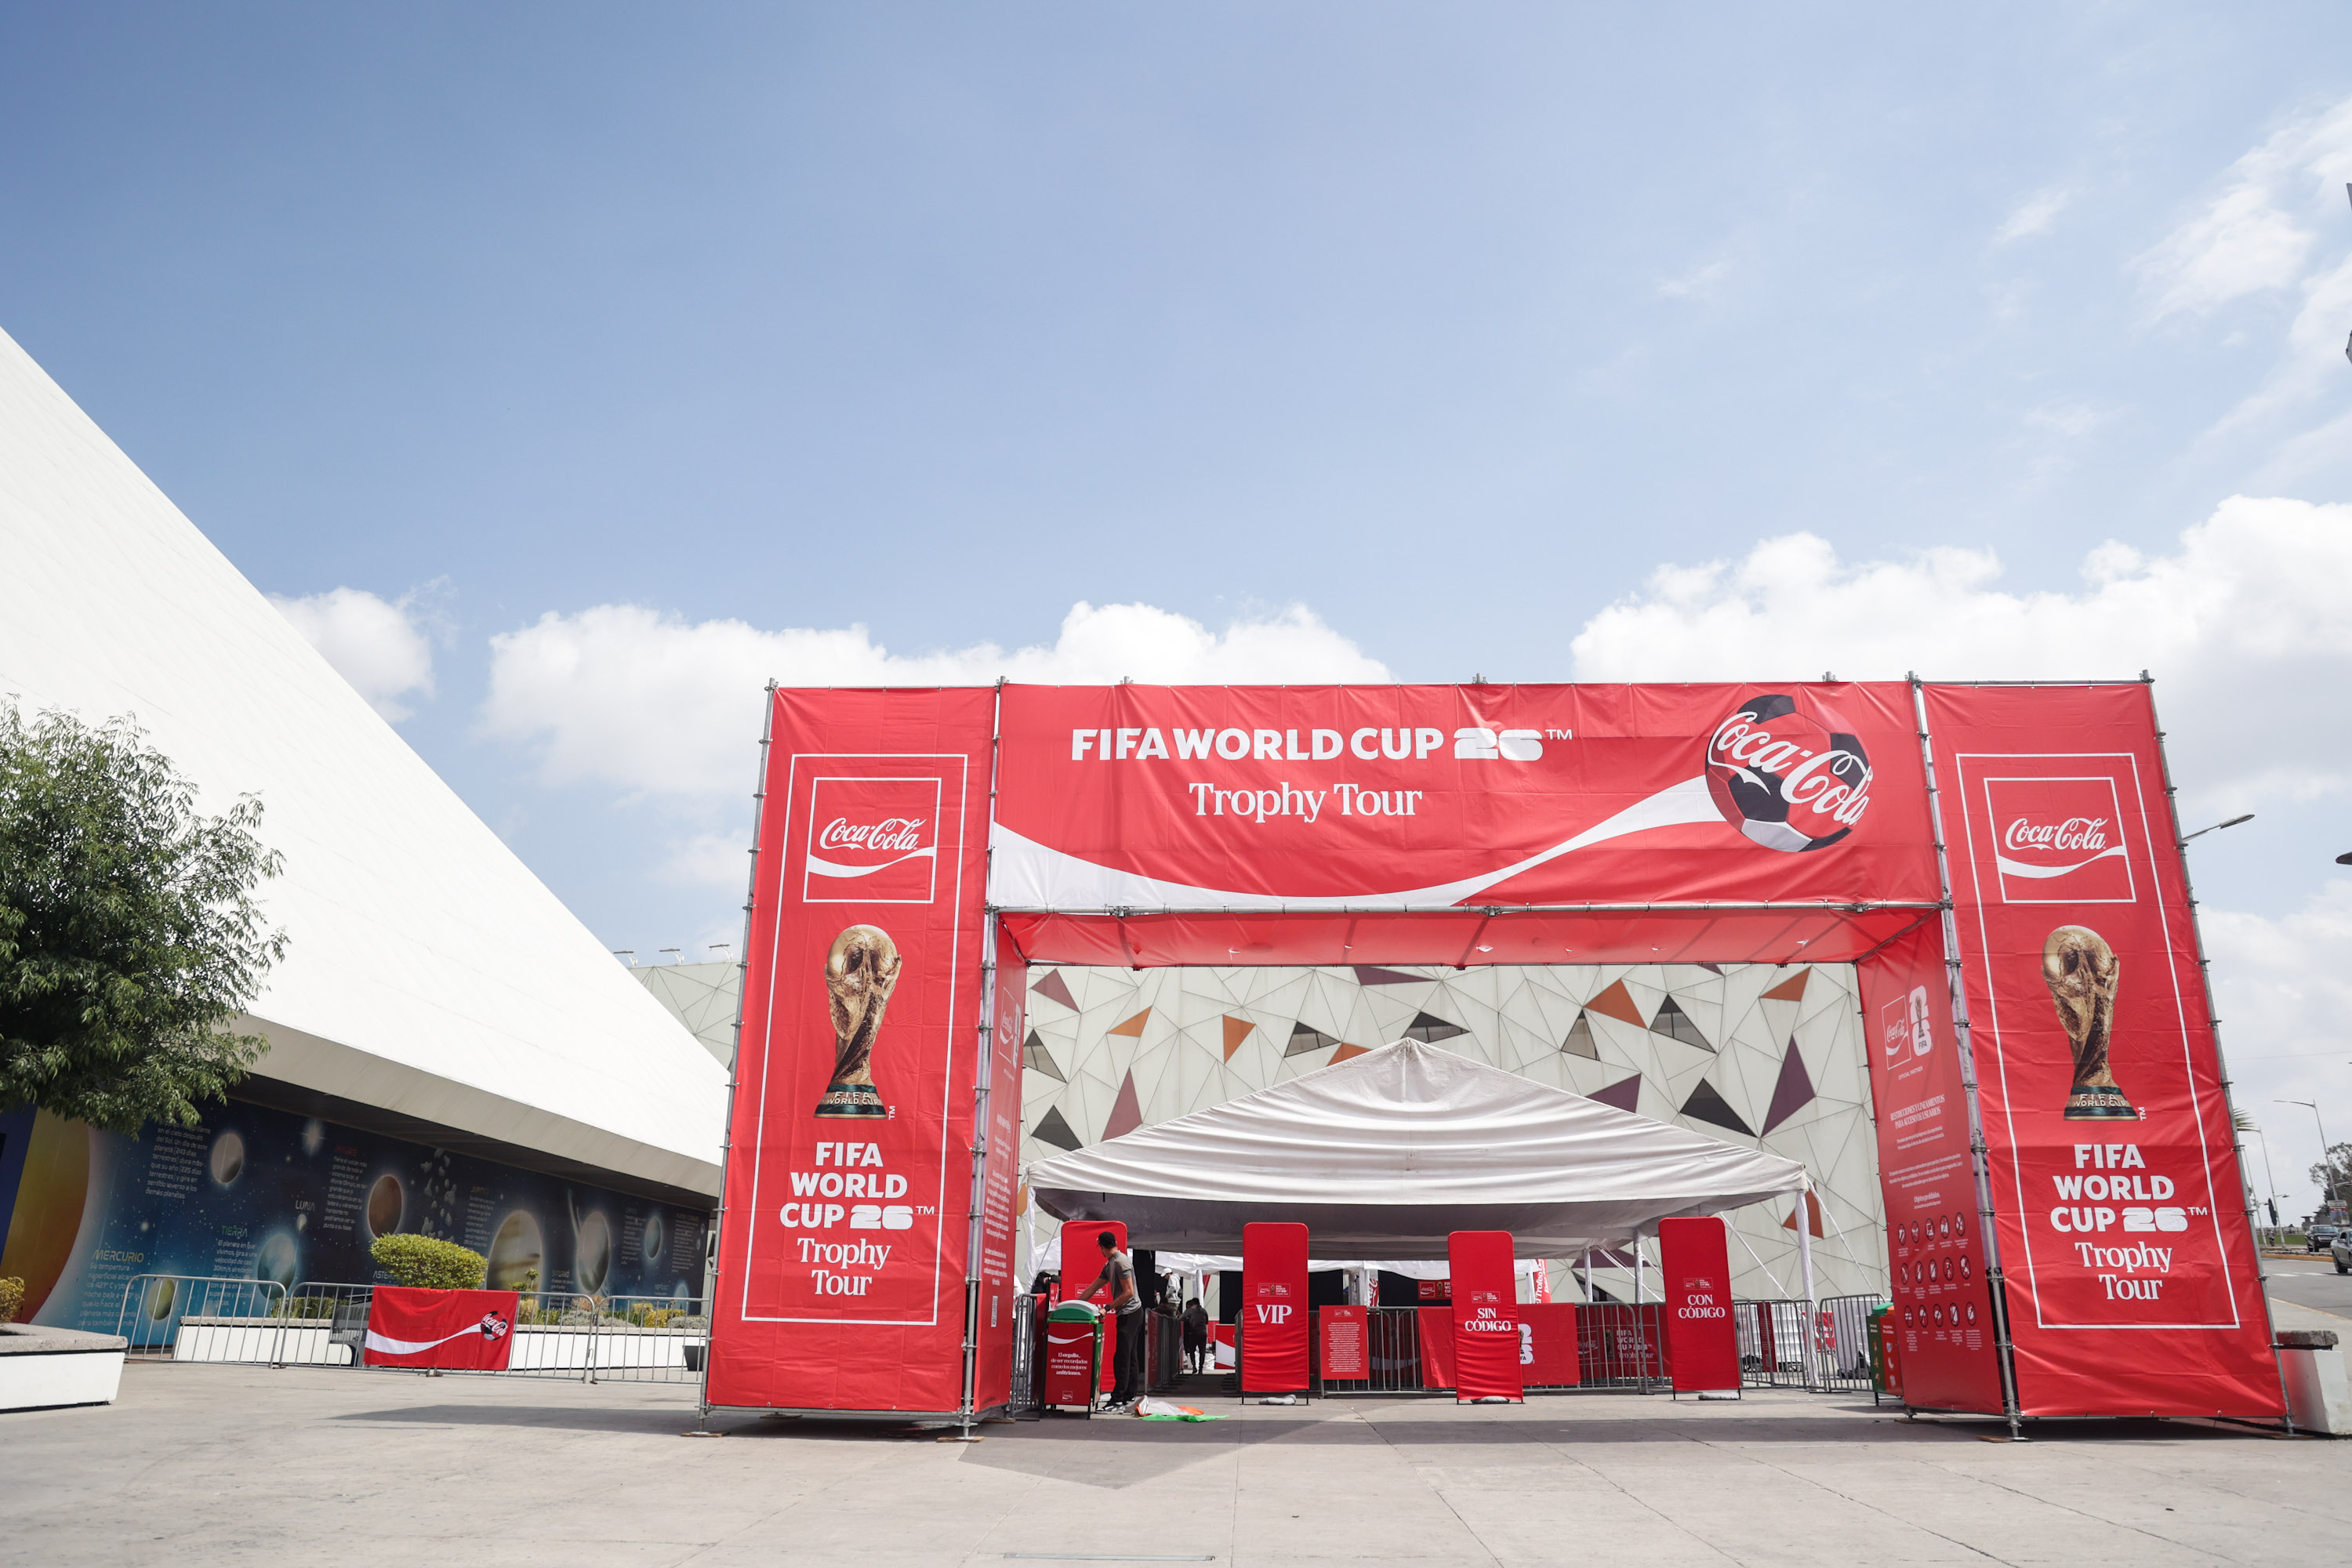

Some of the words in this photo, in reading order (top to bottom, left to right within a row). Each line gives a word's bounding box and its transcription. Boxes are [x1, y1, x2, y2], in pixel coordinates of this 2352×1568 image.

[1071, 728, 1171, 760] FIFA
[1172, 728, 1344, 760] WORLD
[1350, 727, 1444, 760] CUP
[1707, 711, 1874, 826] Coca-Cola
[1189, 782, 1327, 823] Trophy
[1333, 783, 1423, 816] Tour
[819, 817, 927, 851] Coca-Cola
[2005, 817, 2109, 851] Coca-Cola
[1918, 1040, 1927, 1050] FIFA
[815, 1142, 884, 1167] FIFA
[2074, 1144, 2146, 1169] FIFA
[790, 1171, 908, 1199] WORLD
[2053, 1175, 2175, 1201] WORLD
[295, 1200, 315, 1211] LUNA
[779, 1202, 845, 1229] CUP
[222, 1225, 248, 1237] TIERRA
[2050, 1207, 2116, 1232] CUP
[92, 1249, 144, 1263] MERCURIO
[797, 1237, 892, 1271] Trophy
[2074, 1241, 2172, 1275] Trophy
[811, 1269, 873, 1296] Tour
[1535, 1272, 1544, 1298] Trofeo
[2098, 1274, 2163, 1300] Tour
[1678, 1305, 1726, 1319] CÓDIGO
[1687, 1294, 1713, 1306] CON
[1255, 1305, 1293, 1324] VIP
[1465, 1318, 1512, 1332] CÓDIGO
[1477, 1308, 1497, 1319] SIN
